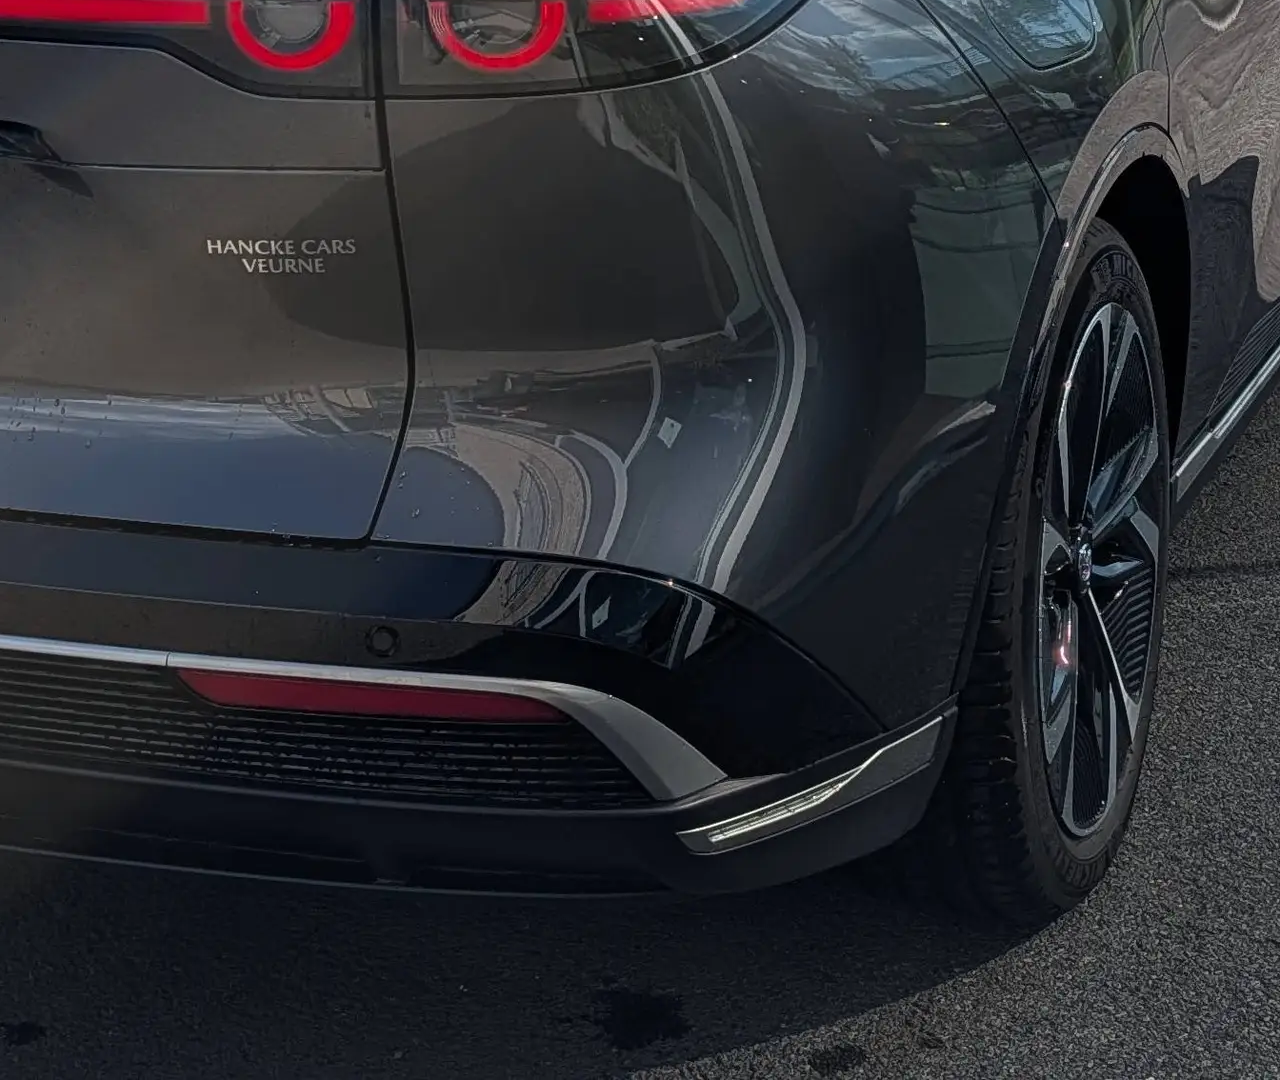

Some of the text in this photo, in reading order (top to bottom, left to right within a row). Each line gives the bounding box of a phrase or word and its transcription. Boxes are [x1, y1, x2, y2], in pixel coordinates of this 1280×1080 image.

[206, 238, 357, 256] HANCKE CARS
[241, 257, 326, 274] VEURNE
